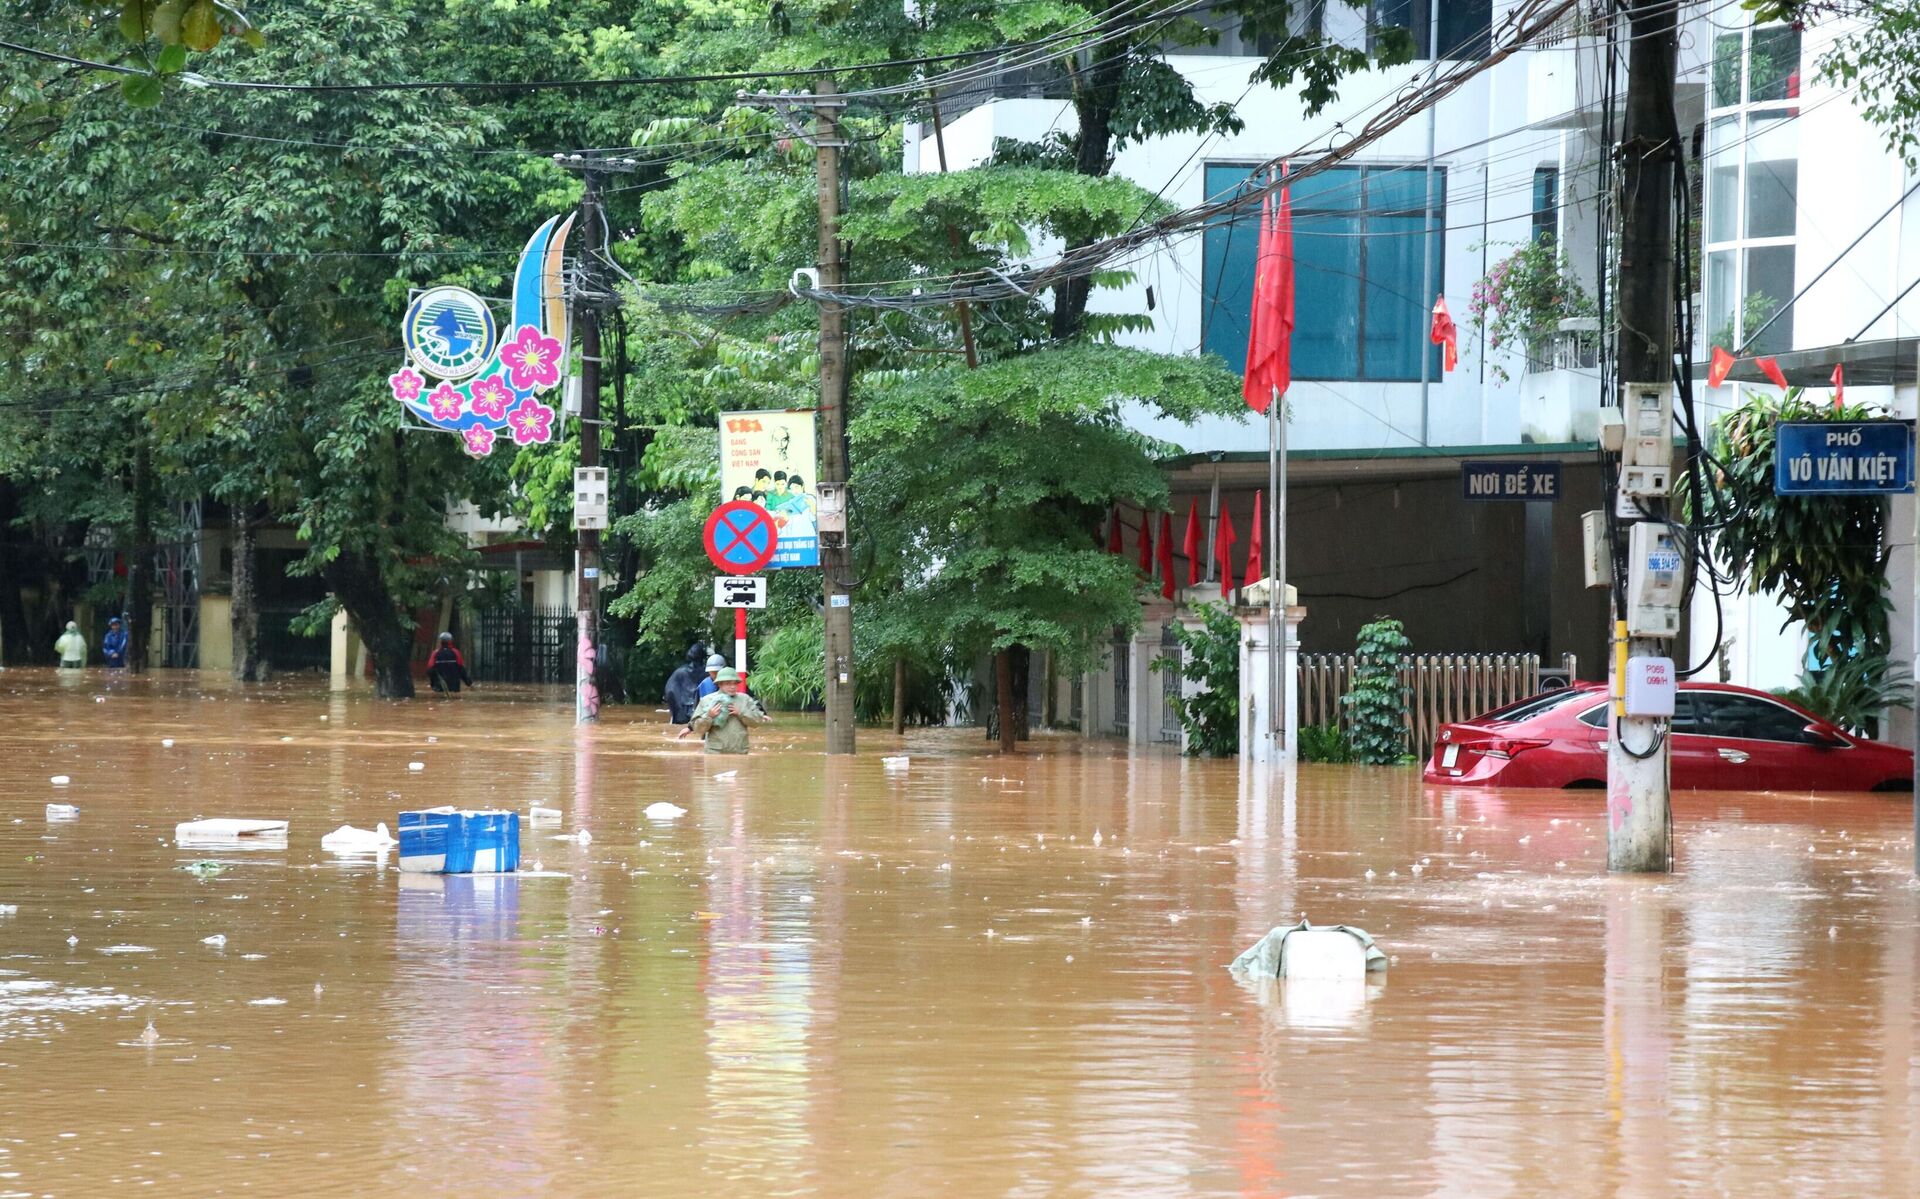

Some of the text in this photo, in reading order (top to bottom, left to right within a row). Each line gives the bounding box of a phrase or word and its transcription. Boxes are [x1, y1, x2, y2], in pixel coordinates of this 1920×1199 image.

[1826, 427, 1862, 446] PHỐ
[1470, 465, 1554, 495] NƠI ĐỂ XE
[1789, 451, 1897, 485] VÕ VĂN KIỆT
